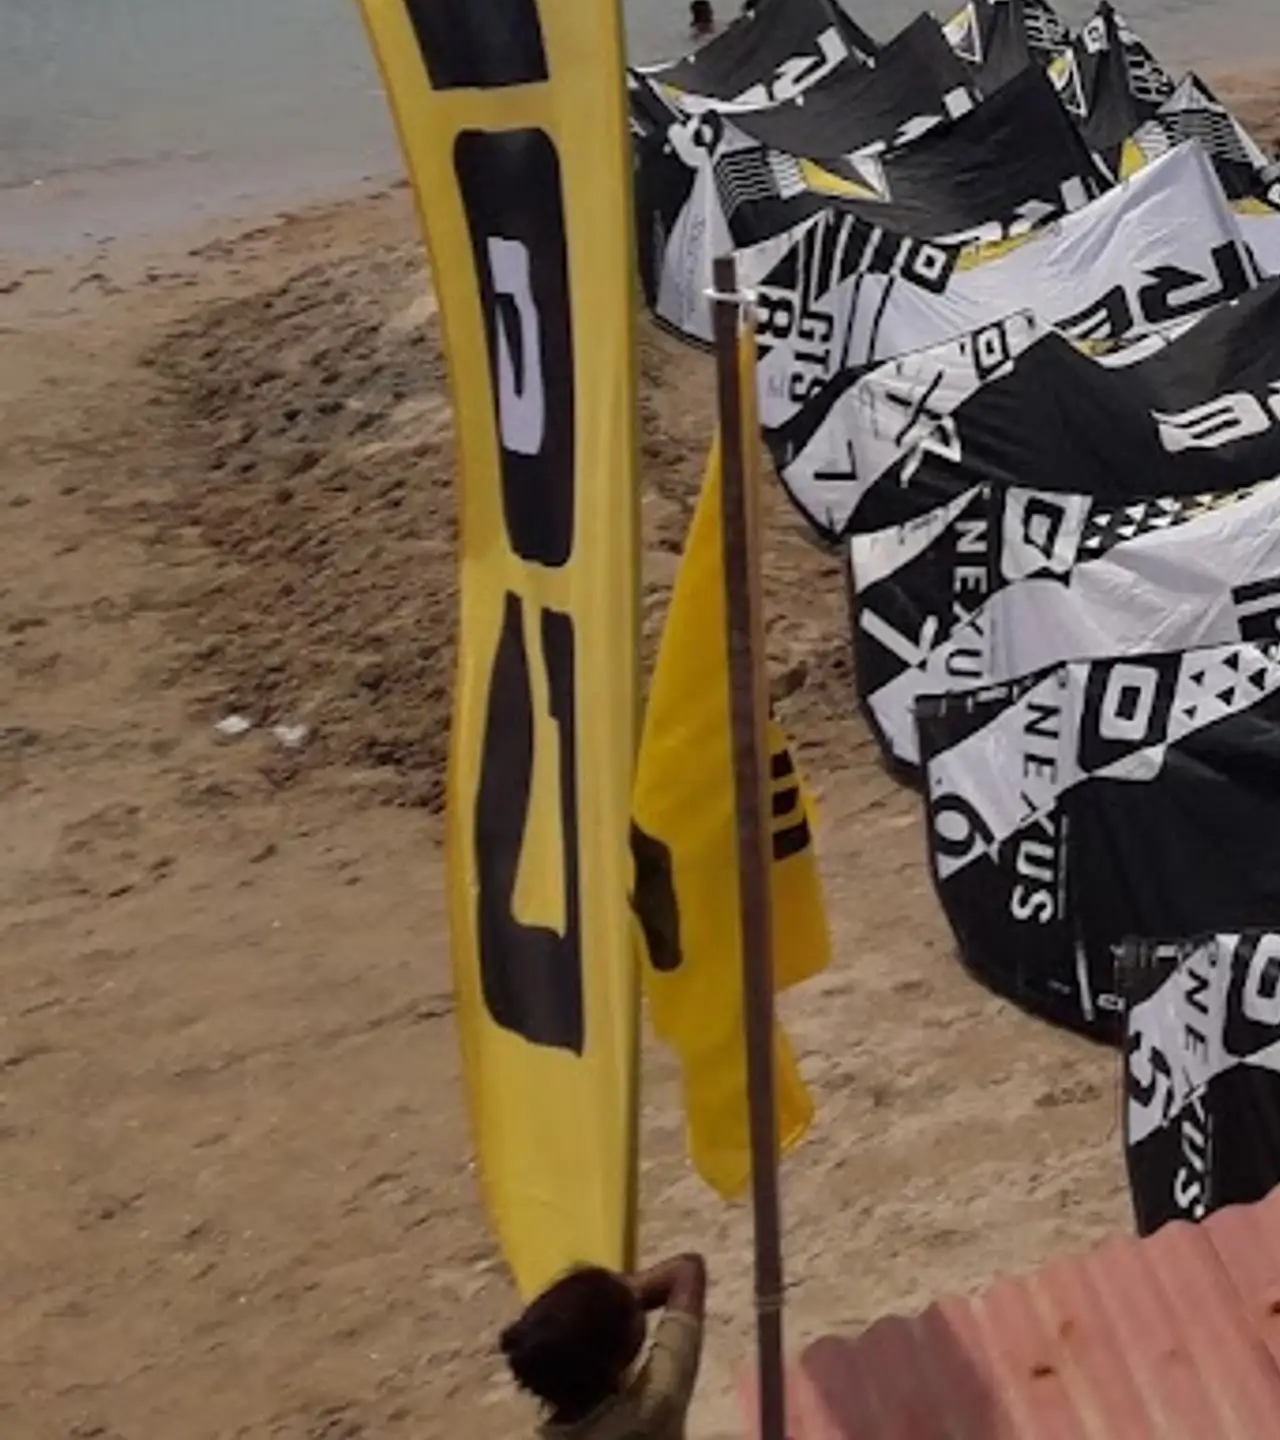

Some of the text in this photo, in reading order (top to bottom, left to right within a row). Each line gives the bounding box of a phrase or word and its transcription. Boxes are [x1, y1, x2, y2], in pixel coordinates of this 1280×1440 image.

[788, 310, 836, 403] GTS
[1010, 699, 1063, 924] NEXUS
[1173, 965, 1212, 1218] NEXUS
